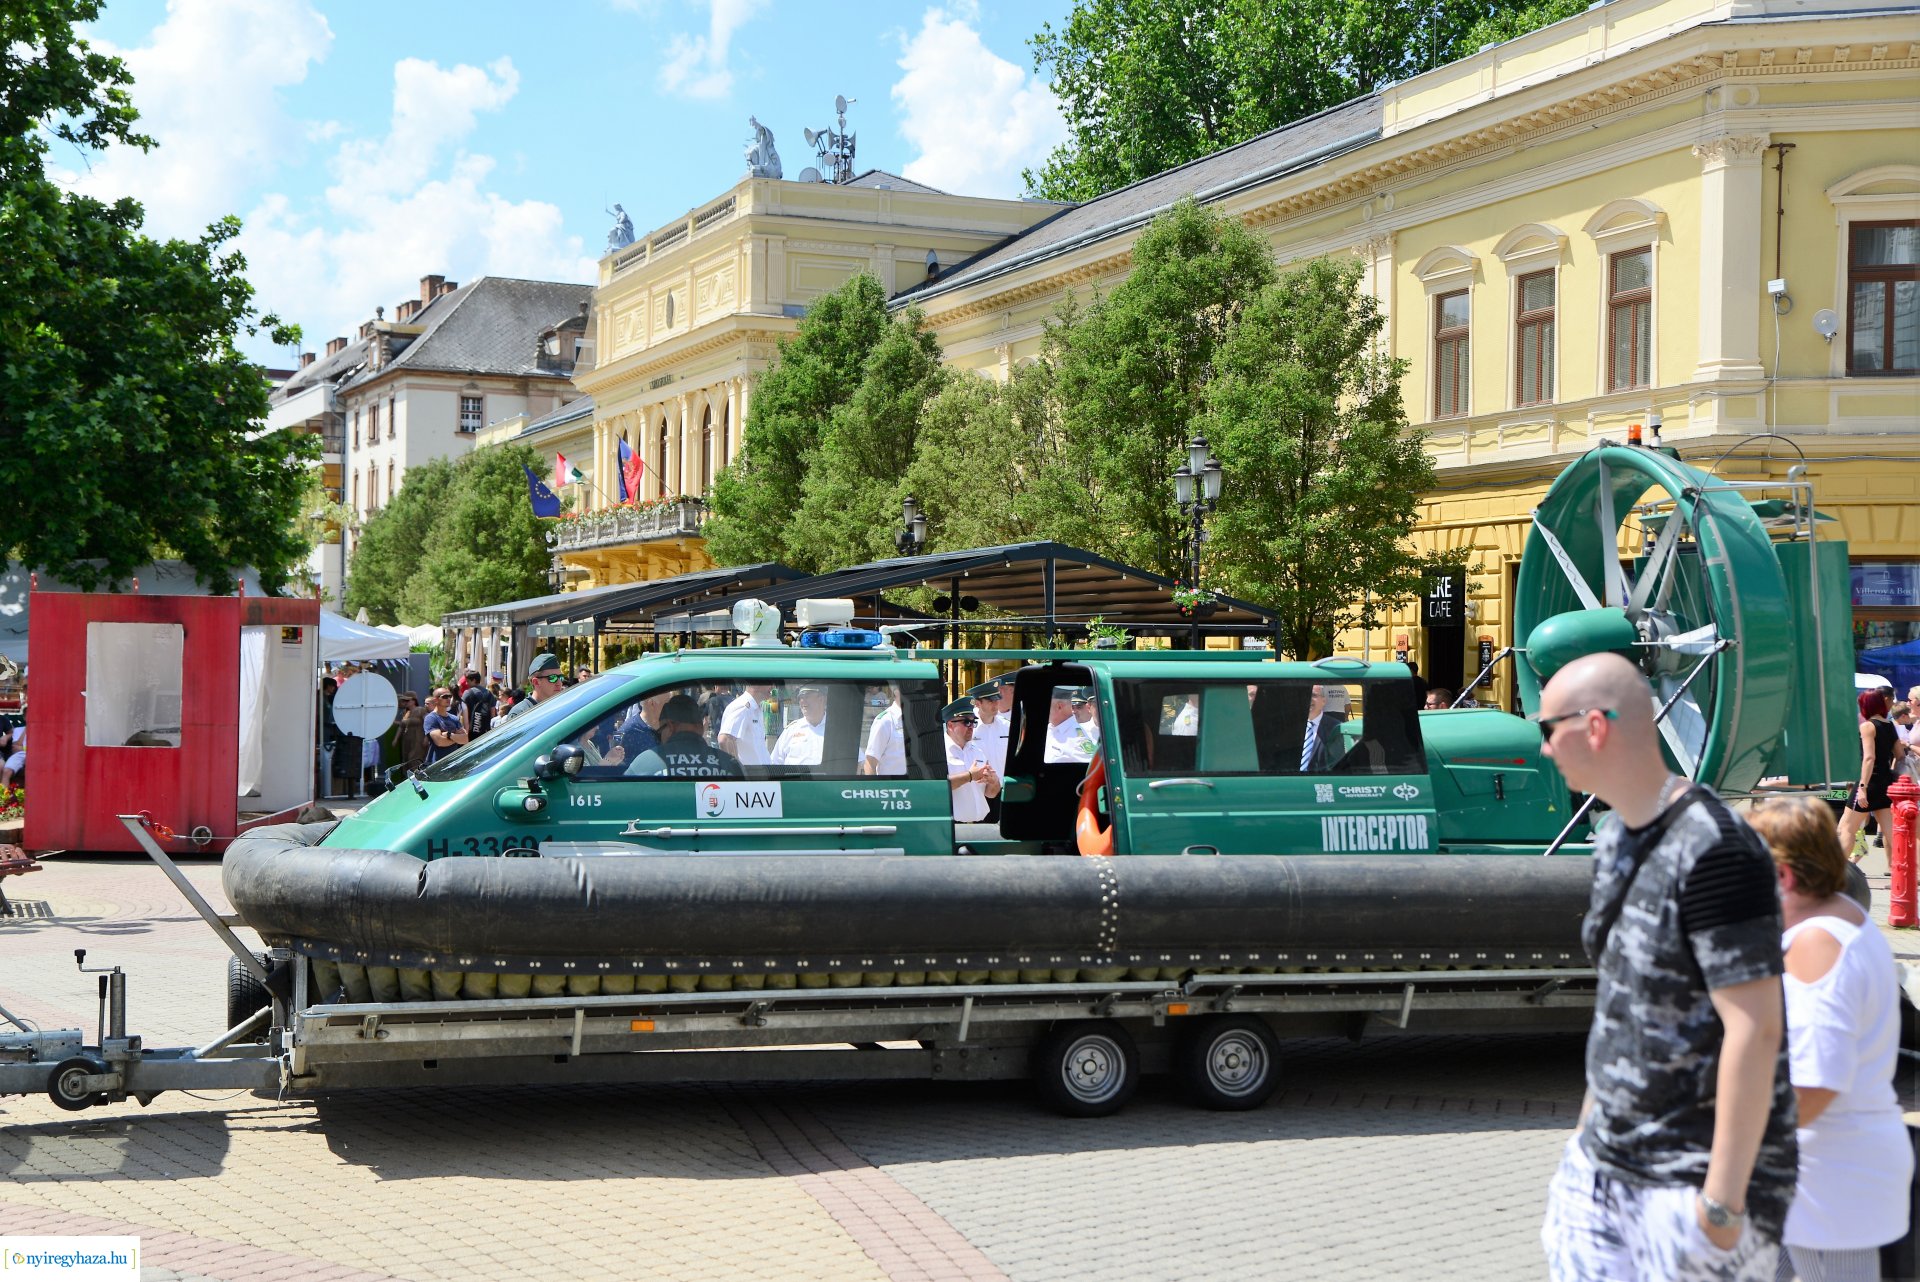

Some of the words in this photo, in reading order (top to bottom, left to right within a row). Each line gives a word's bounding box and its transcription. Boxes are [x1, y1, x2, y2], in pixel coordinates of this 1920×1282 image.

[1429, 601, 1452, 618] CAFE
[666, 754, 703, 765] TAX
[706, 754, 720, 765] &
[840, 788, 910, 799] CHRISTY
[1338, 785, 1387, 794] CHRISTY
[569, 794, 602, 807] 1615
[735, 791, 776, 809] NAV
[880, 800, 912, 810] 7183
[1321, 814, 1429, 852] INTERCEPTOR
